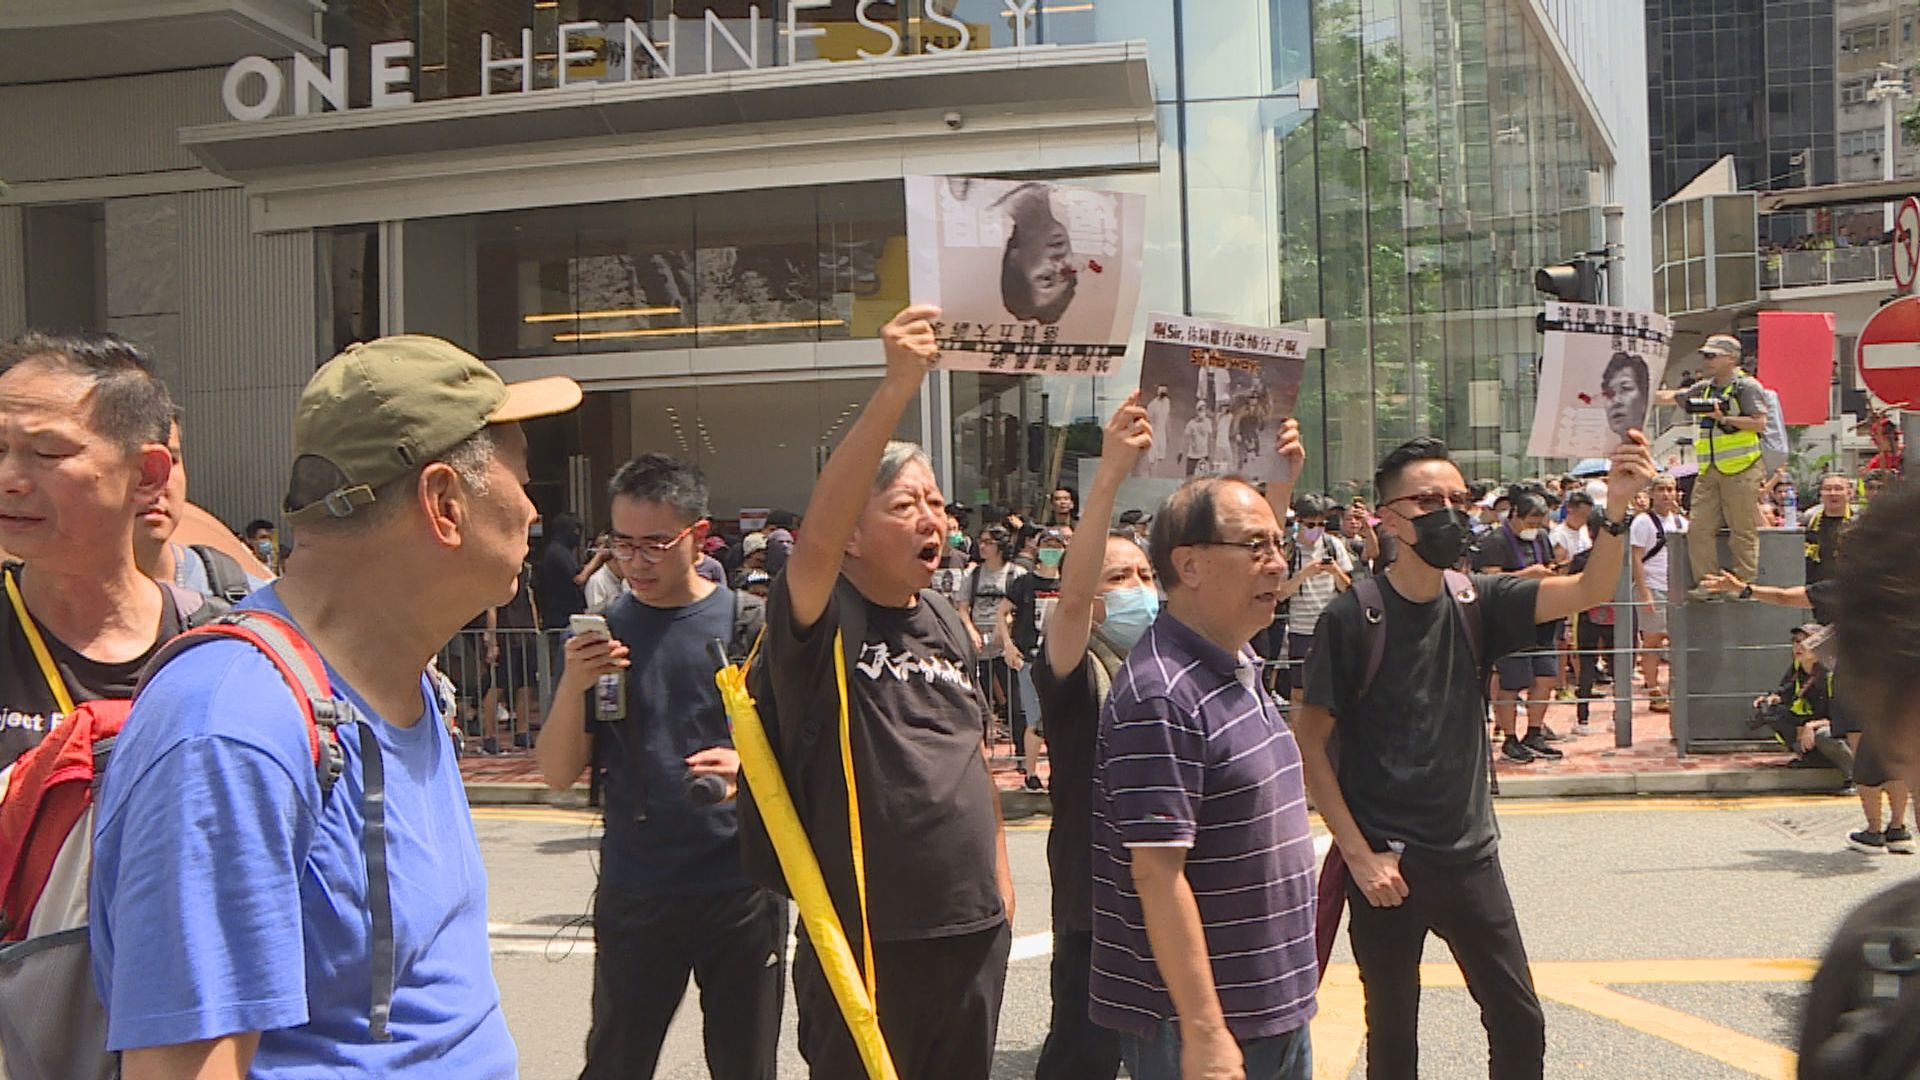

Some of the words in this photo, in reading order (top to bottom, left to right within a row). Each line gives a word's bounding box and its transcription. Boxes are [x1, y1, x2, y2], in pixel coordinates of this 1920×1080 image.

[222, 40, 414, 121] ONE
[481, 0, 1036, 97] HENNESSY
[0, 707, 45, 731] ject
